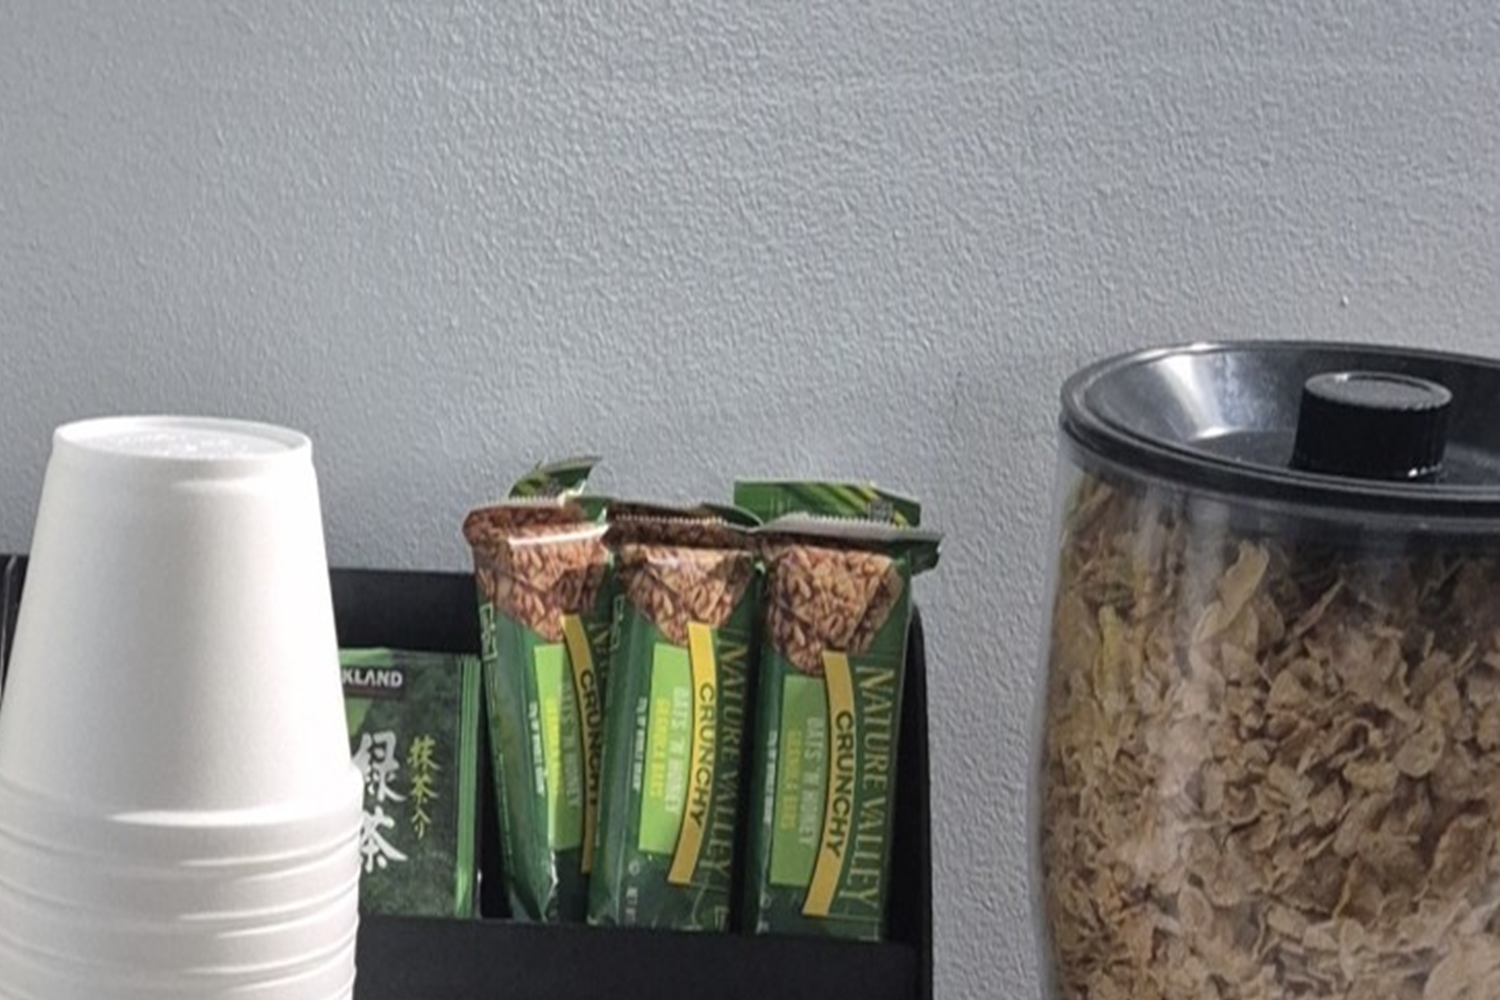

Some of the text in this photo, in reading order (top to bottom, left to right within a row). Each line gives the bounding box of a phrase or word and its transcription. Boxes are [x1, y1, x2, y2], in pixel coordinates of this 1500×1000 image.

[689, 681, 716, 828] CRUNCHY
[699, 640, 748, 878] NATURE VALLEY
[826, 710, 855, 858] CRUNCHY
[838, 664, 895, 910] NATURE VALLEY
